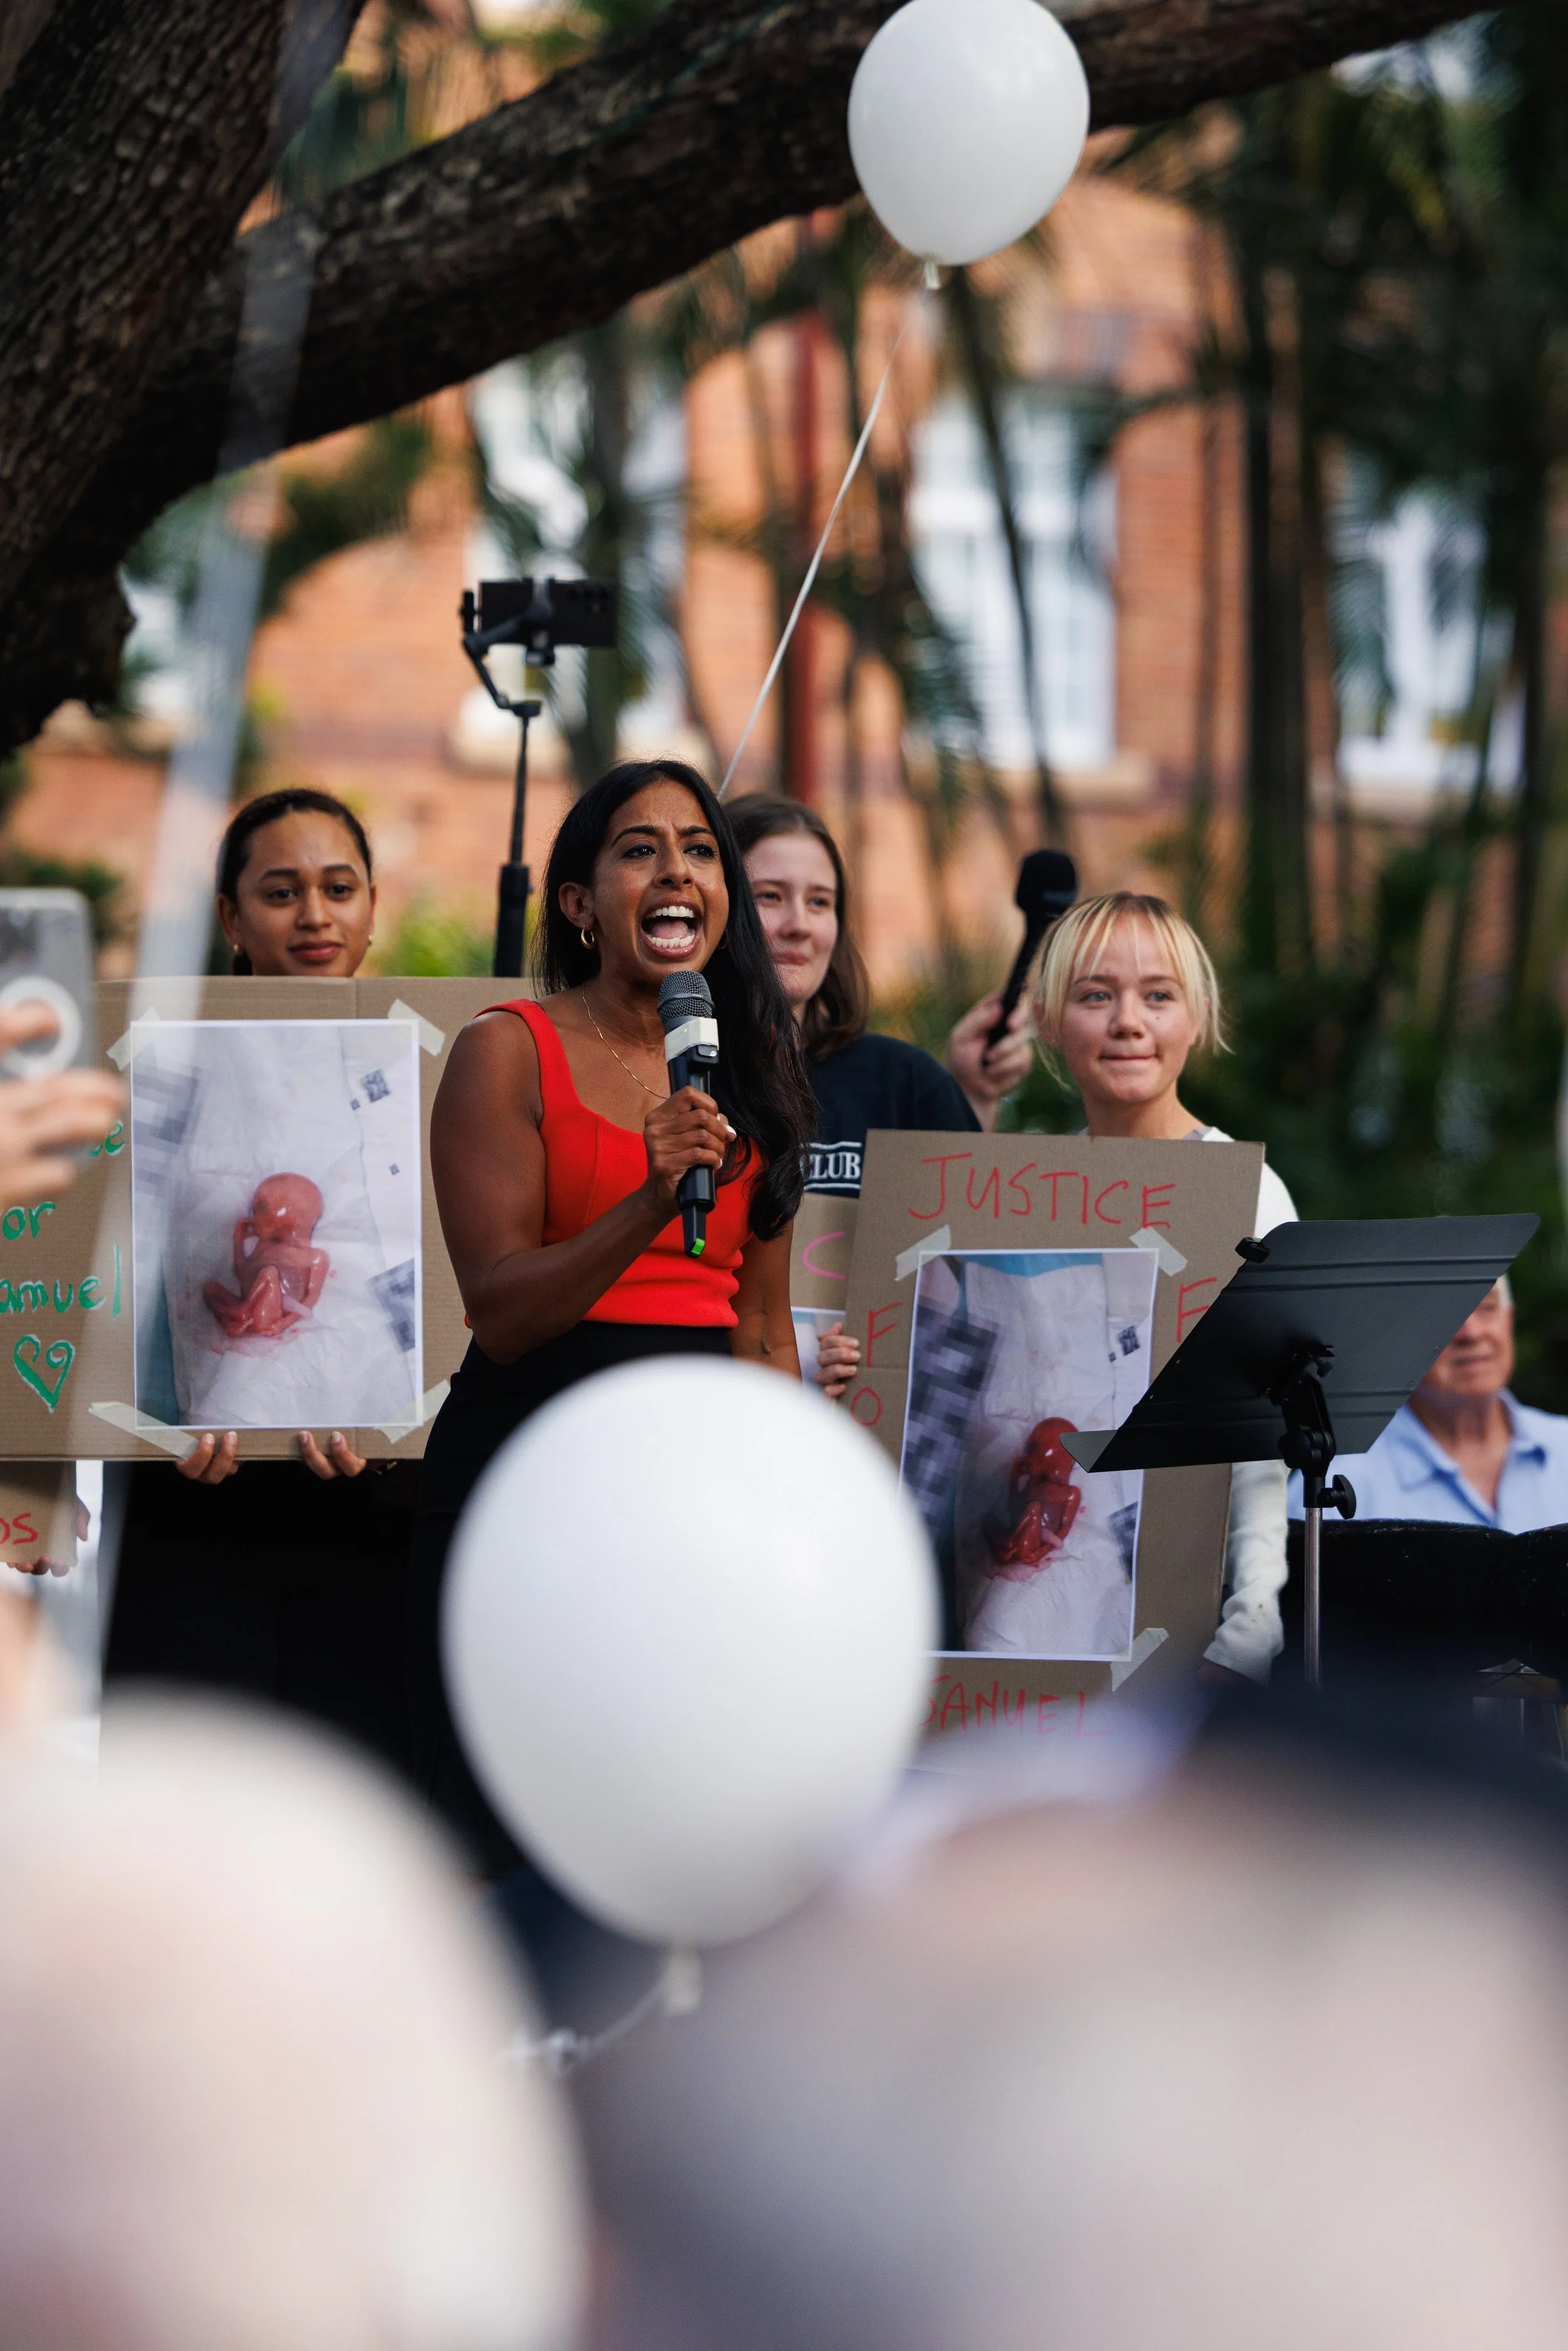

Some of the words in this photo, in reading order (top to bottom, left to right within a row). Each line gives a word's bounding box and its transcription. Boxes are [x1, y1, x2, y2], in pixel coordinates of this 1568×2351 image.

[0, 1201, 56, 1239] or
[908, 1153, 1176, 1228] JUSTICE
[0, 1244, 122, 1320] amuel
